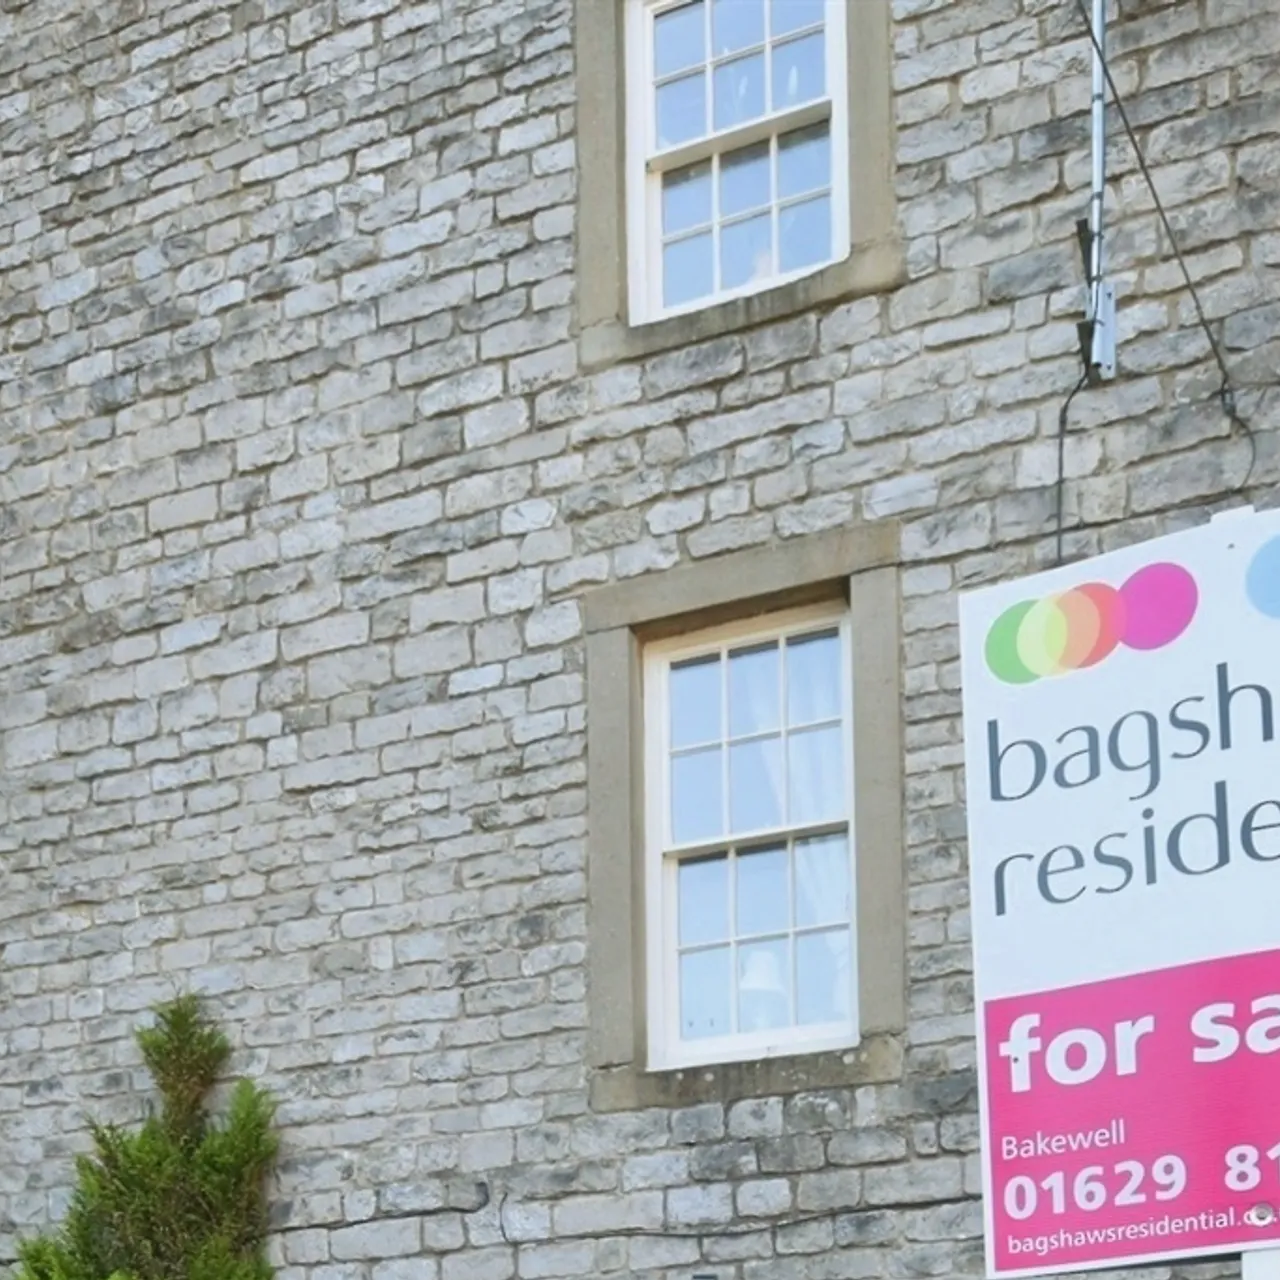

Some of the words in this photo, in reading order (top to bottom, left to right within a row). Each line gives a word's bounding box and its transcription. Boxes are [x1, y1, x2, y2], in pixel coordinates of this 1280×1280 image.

[999, 1013, 1155, 1093] for
[1001, 1118, 1126, 1161] Bakewell
[1003, 1154, 1188, 1221] 01629
